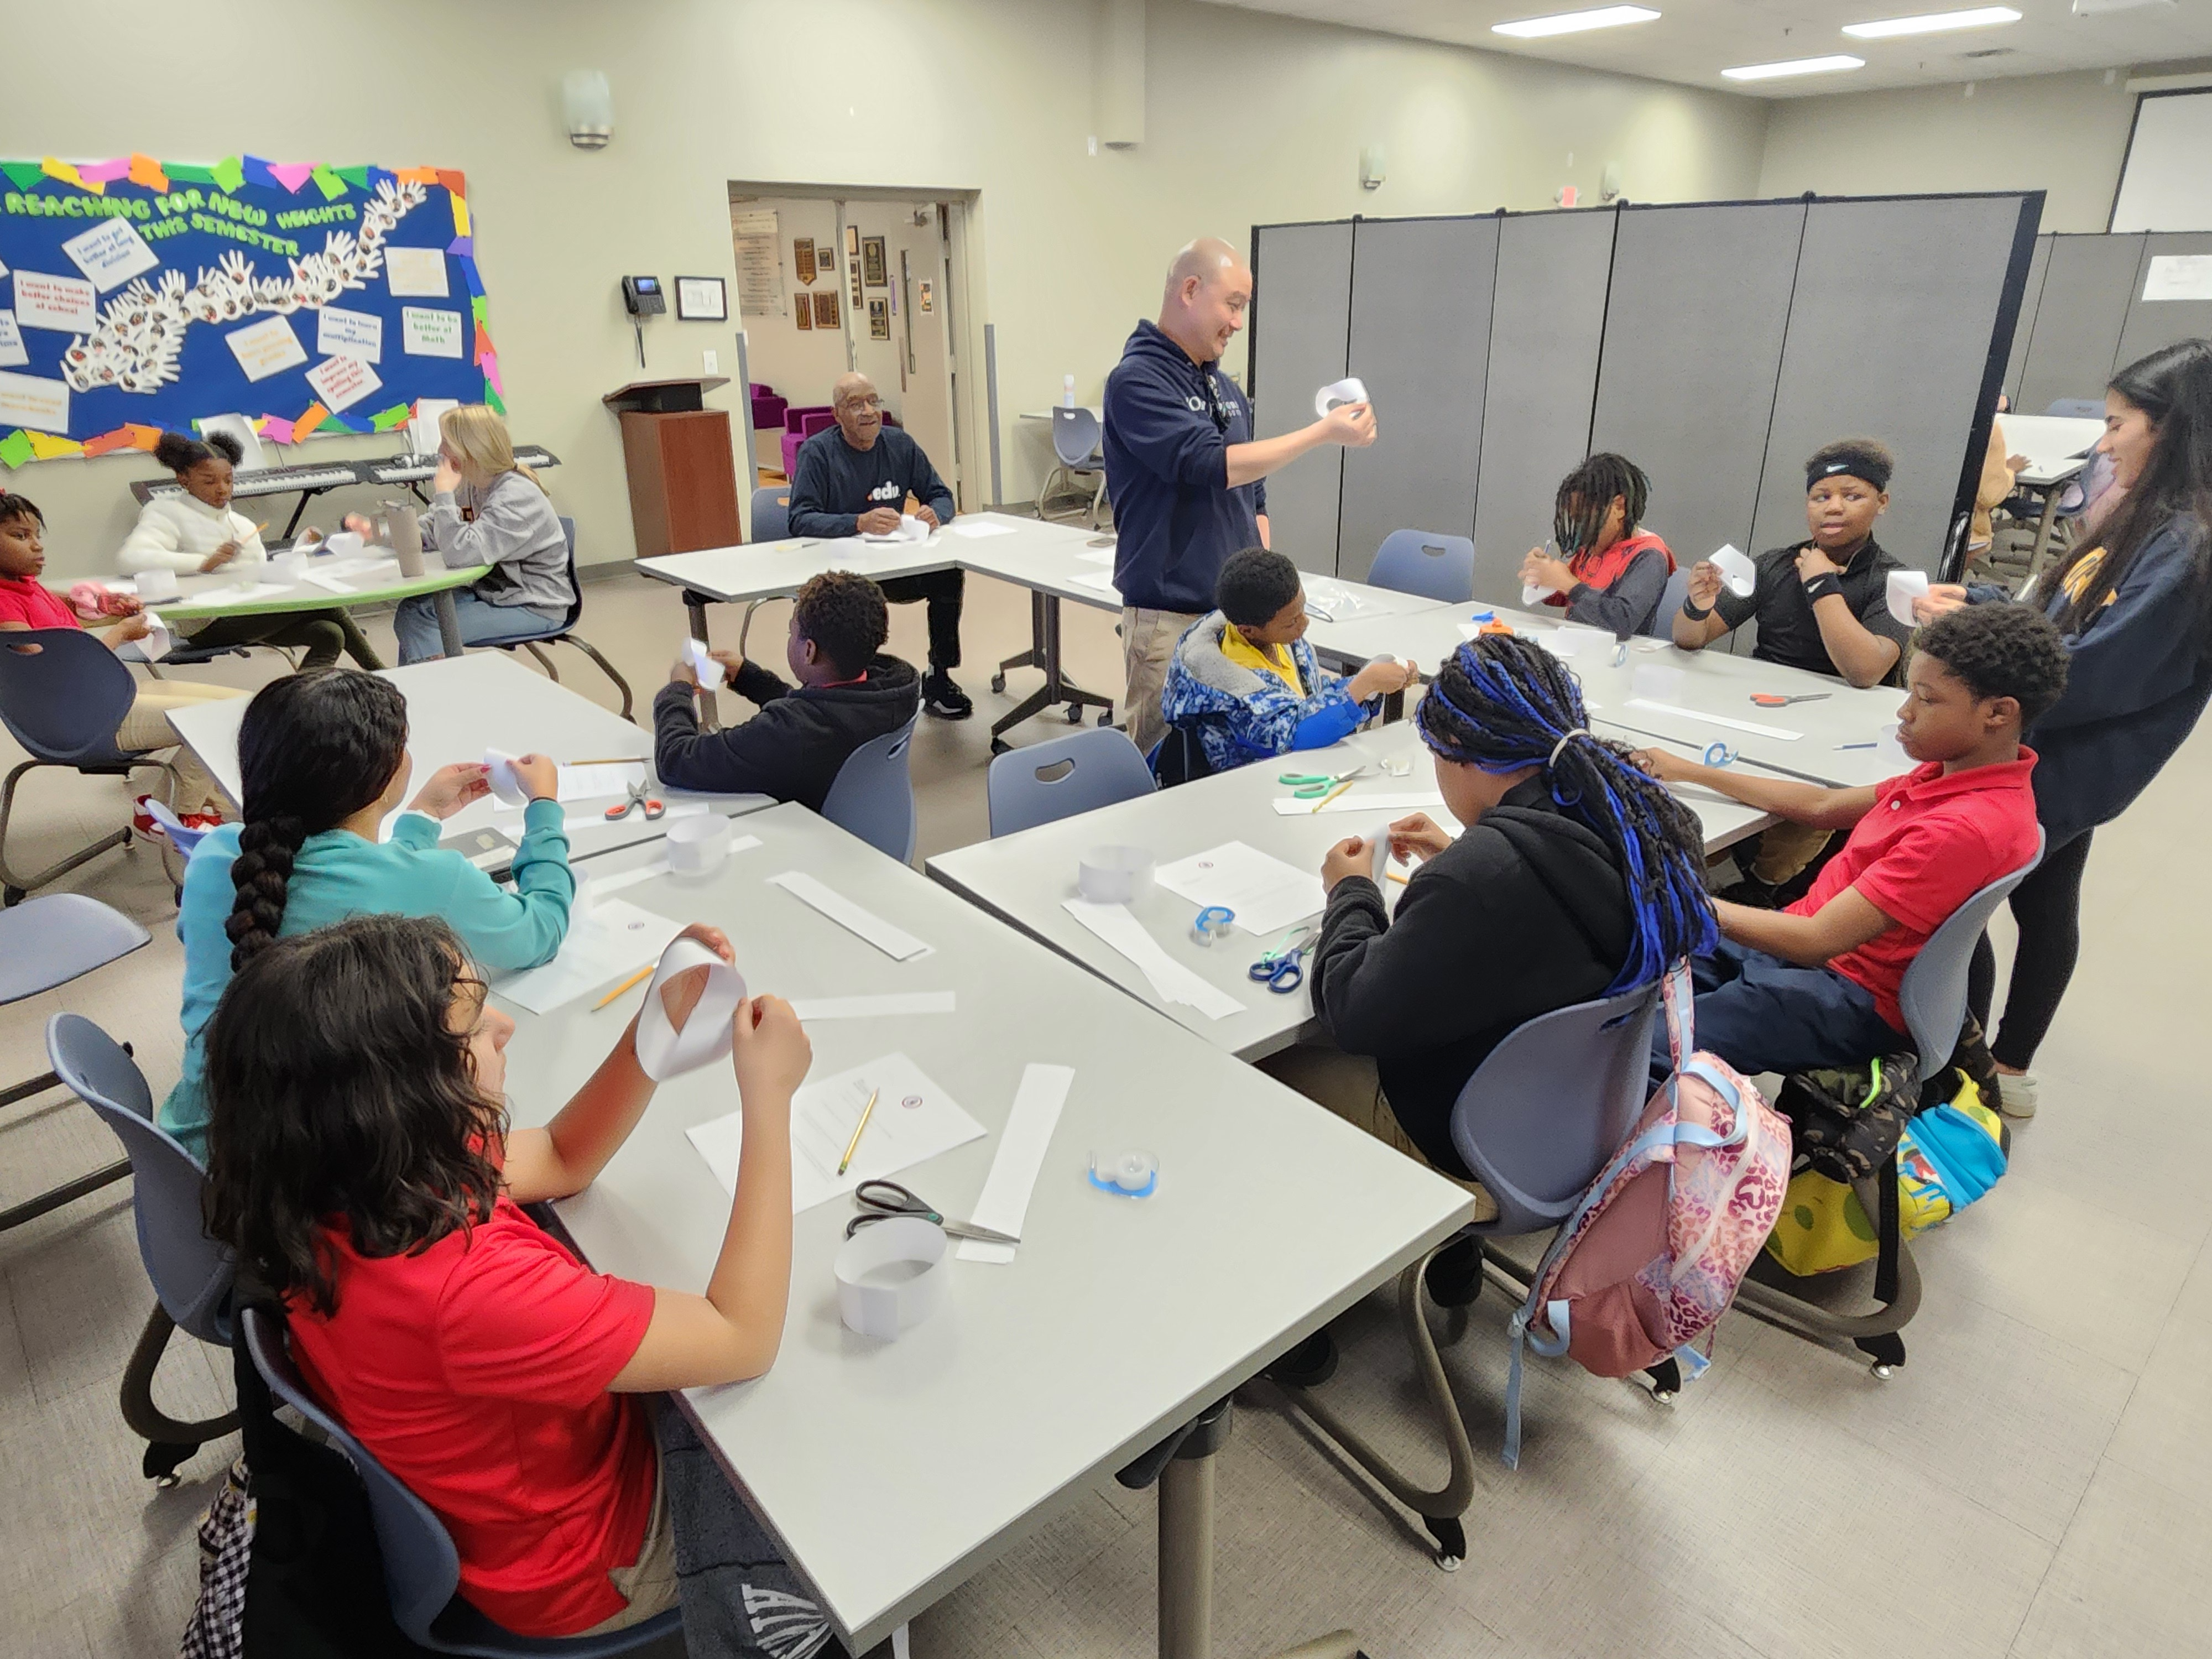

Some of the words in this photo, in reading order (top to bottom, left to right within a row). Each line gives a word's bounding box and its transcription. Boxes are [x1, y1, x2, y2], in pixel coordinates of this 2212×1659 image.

[5, 192, 151, 220] REACHING
[154, 189, 206, 217] FOR
[208, 191, 268, 226] NEW
[275, 203, 357, 229] HEIGHTS
[137, 216, 189, 241] THIS
[190, 212, 299, 257] SEMESTER
[26, 282, 50, 290] want
[65, 288, 90, 296] make
[22, 290, 50, 300] better
[54, 295, 90, 306] choices
[48, 305, 77, 315] school
[411, 312, 434, 321] want
[437, 314, 445, 323] to
[447, 315, 458, 323] be
[413, 322, 440, 332] better
[323, 332, 376, 347] multiplication
